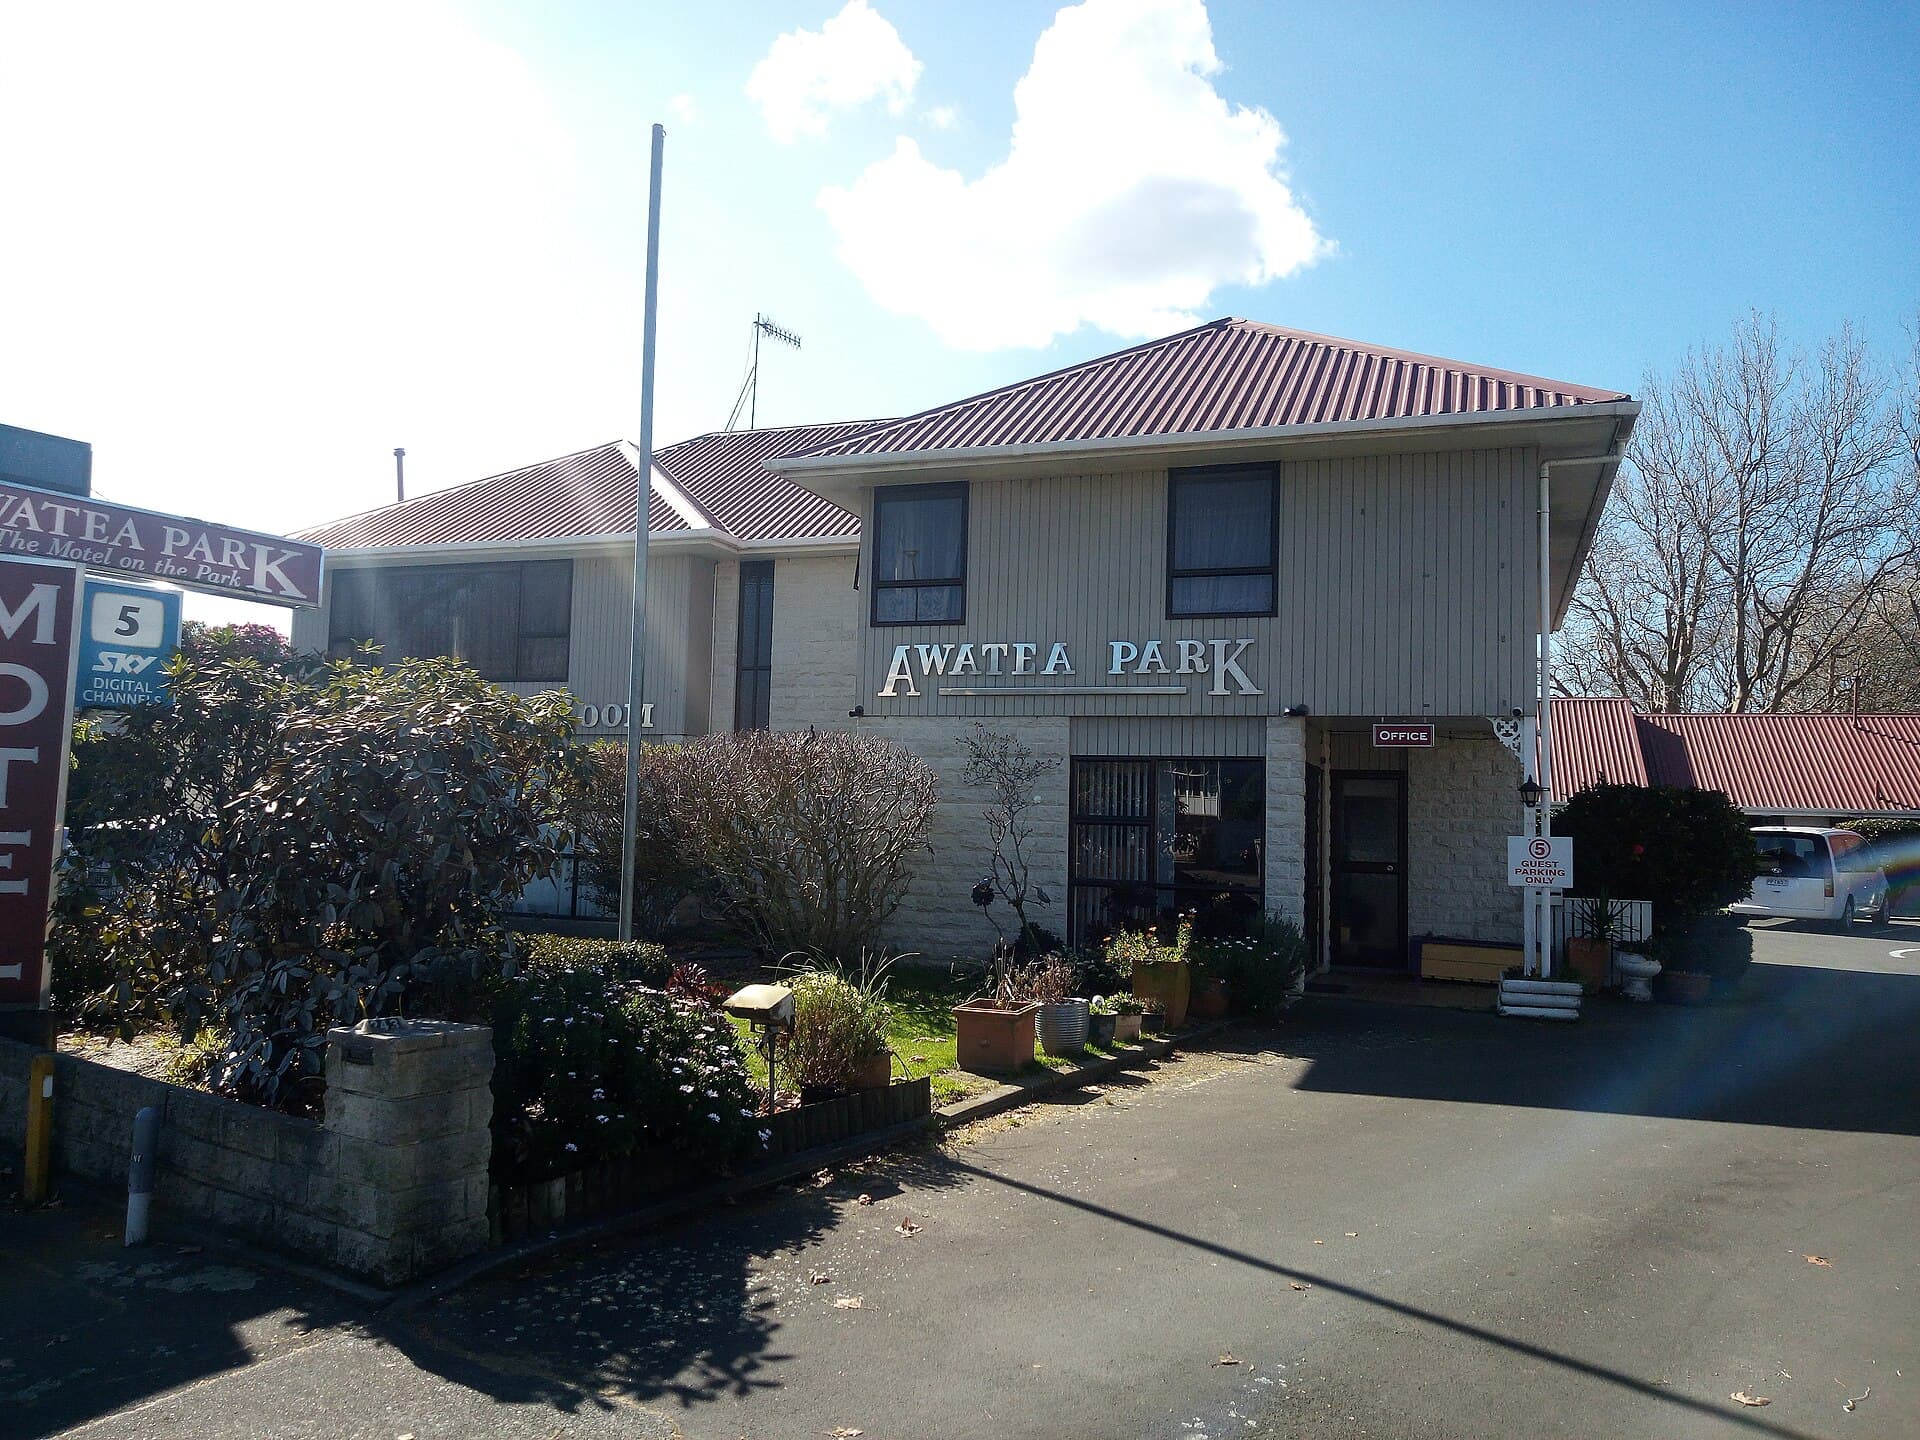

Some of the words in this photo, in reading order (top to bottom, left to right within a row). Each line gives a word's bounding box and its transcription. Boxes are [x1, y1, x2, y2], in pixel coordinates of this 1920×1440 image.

[0, 528, 39, 553] The
[46, 537, 112, 565] Motel
[119, 556, 146, 571] on
[154, 559, 188, 576] the
[195, 563, 241, 587] Park
[160, 526, 307, 599] PARK
[114, 605, 141, 637] 5
[91, 651, 158, 675] SKY
[877, 642, 1076, 697] AWATEA
[1108, 638, 1265, 696] PARK
[93, 677, 153, 694] DIGITAL
[1379, 730, 1428, 741] OFFICE
[1534, 842, 1546, 856] 5
[1514, 868, 1566, 877] PARKING
[1521, 860, 1559, 868] GUEST
[1525, 876, 1554, 885] ONLY
